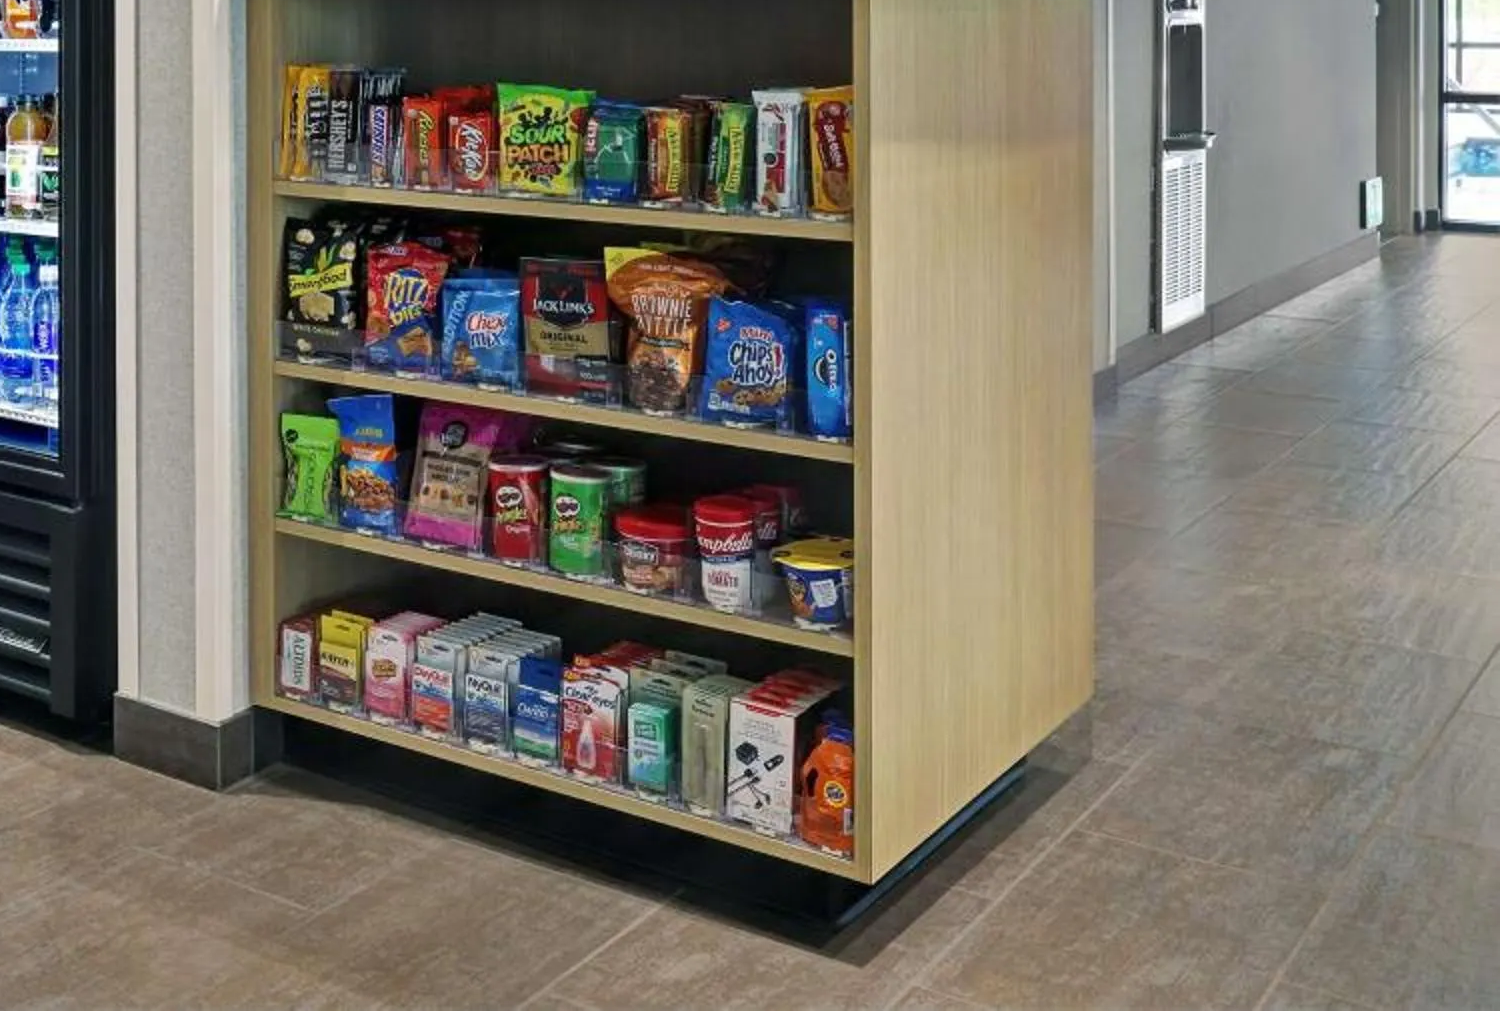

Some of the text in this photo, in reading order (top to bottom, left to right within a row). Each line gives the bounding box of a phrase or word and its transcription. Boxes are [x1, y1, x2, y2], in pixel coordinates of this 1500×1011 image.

[509, 124, 565, 144] SOUR
[508, 143, 570, 164] PATCH
[384, 270, 429, 309] RITZ
[631, 294, 692, 318] BROWNIE
[729, 340, 773, 366] Chips
